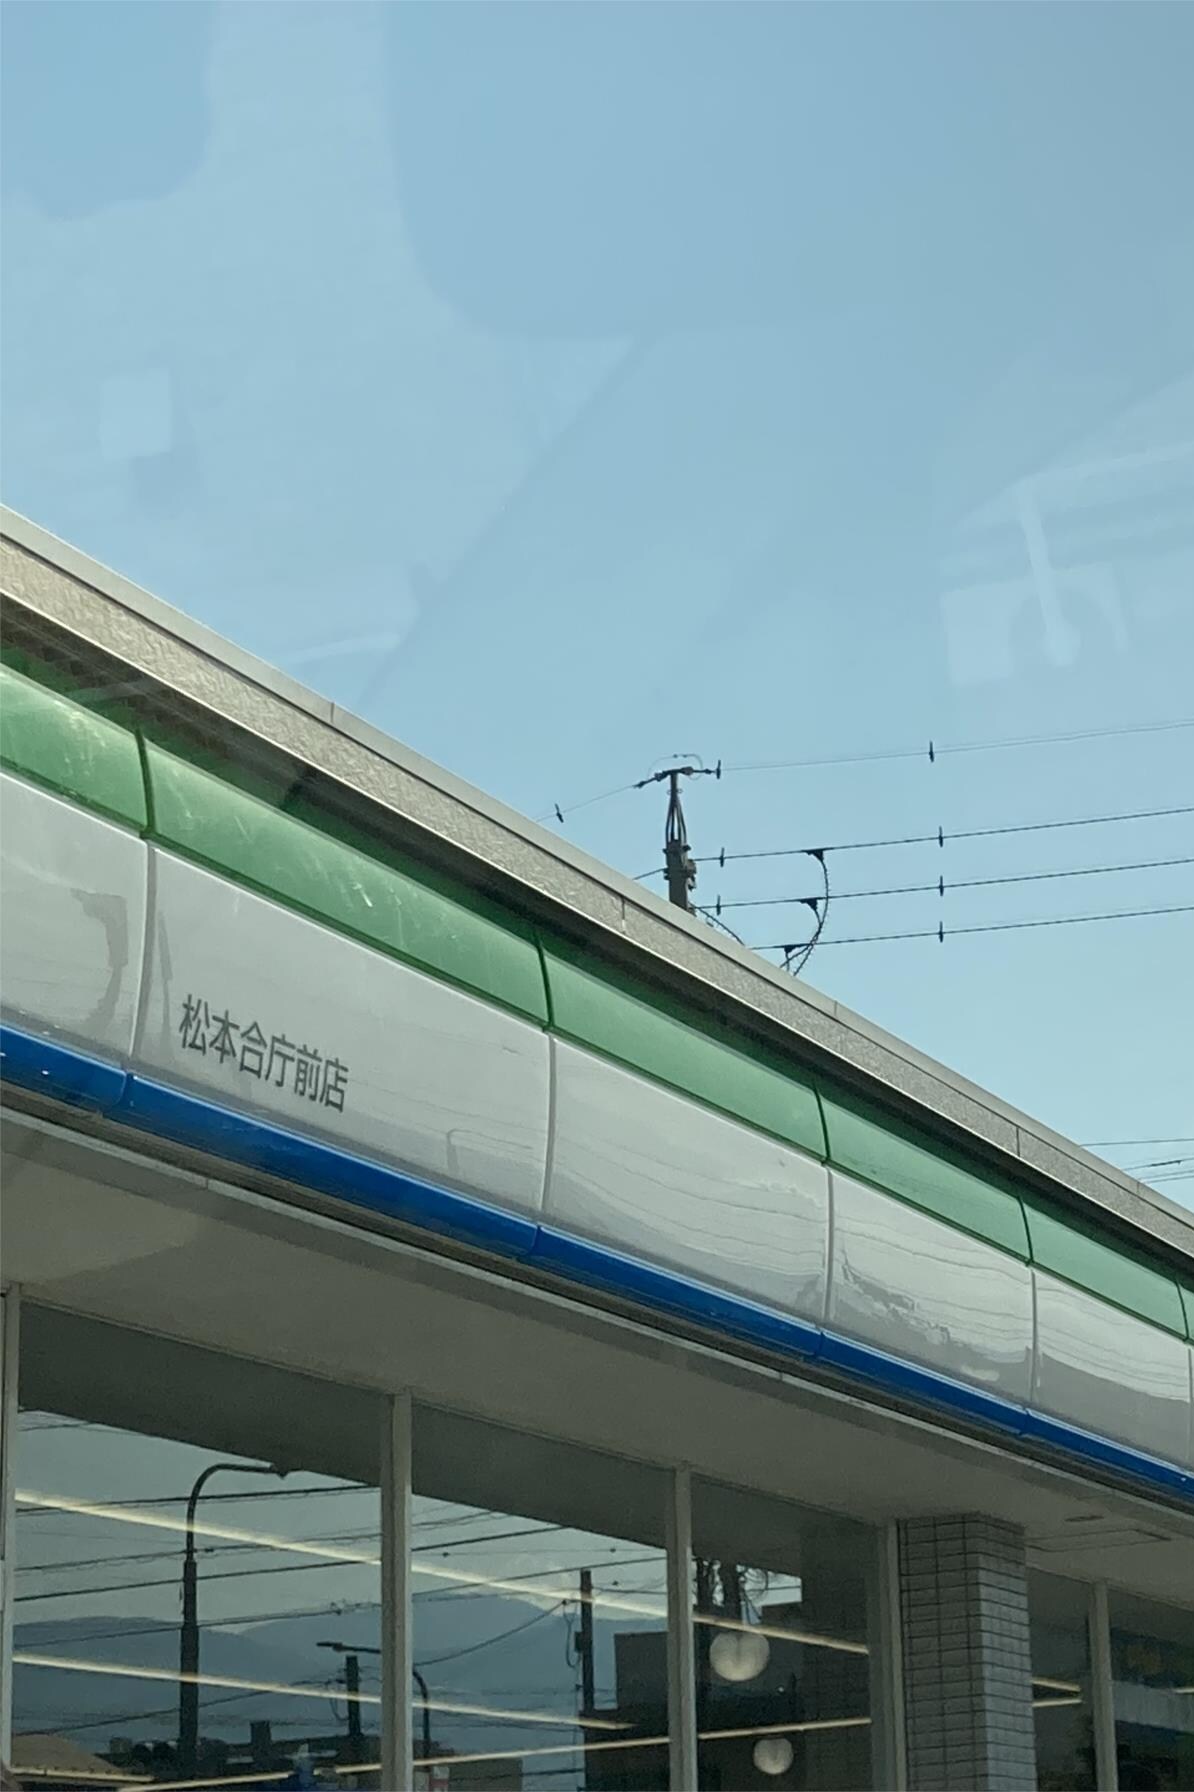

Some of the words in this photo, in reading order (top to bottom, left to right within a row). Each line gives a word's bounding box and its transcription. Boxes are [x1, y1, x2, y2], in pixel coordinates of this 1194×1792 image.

[179, 993, 349, 1113] 松本合庁前店
